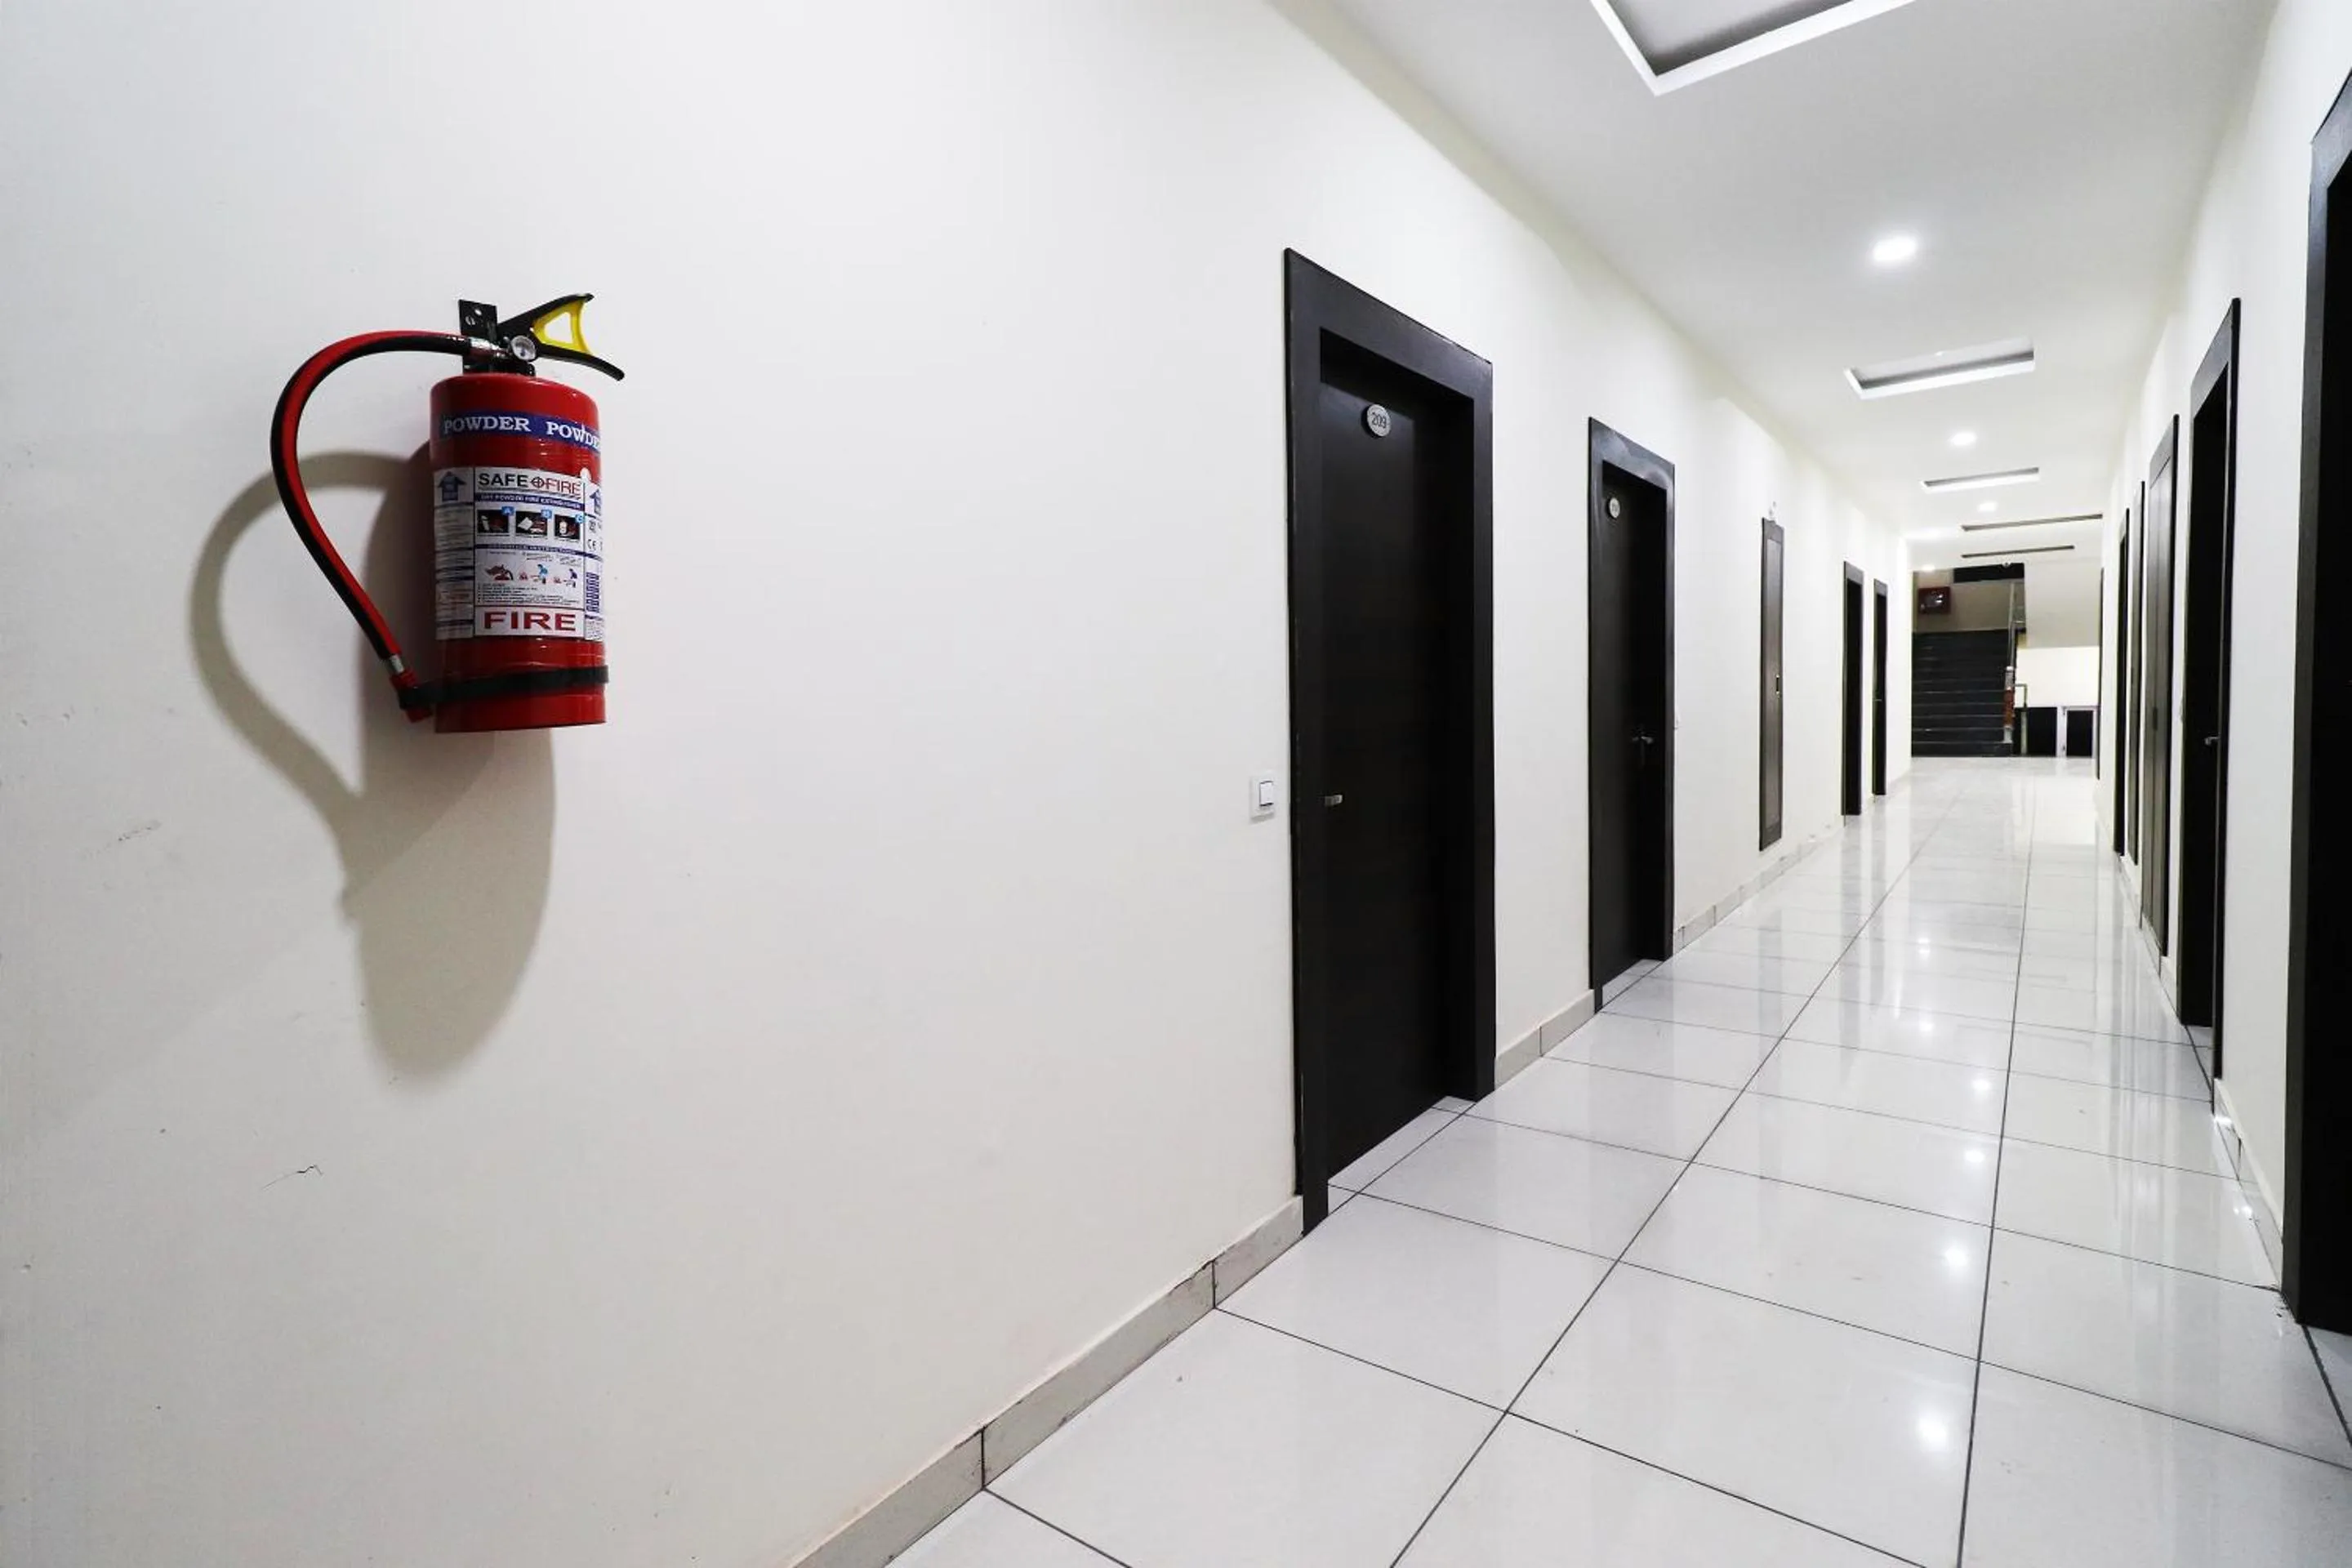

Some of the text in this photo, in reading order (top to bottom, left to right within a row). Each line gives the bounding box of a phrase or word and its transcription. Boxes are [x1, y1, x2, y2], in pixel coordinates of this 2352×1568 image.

[443, 416, 531, 434] POWDER
[478, 473, 581, 495] SAFE FIRE
[483, 612, 576, 631] FIRE
